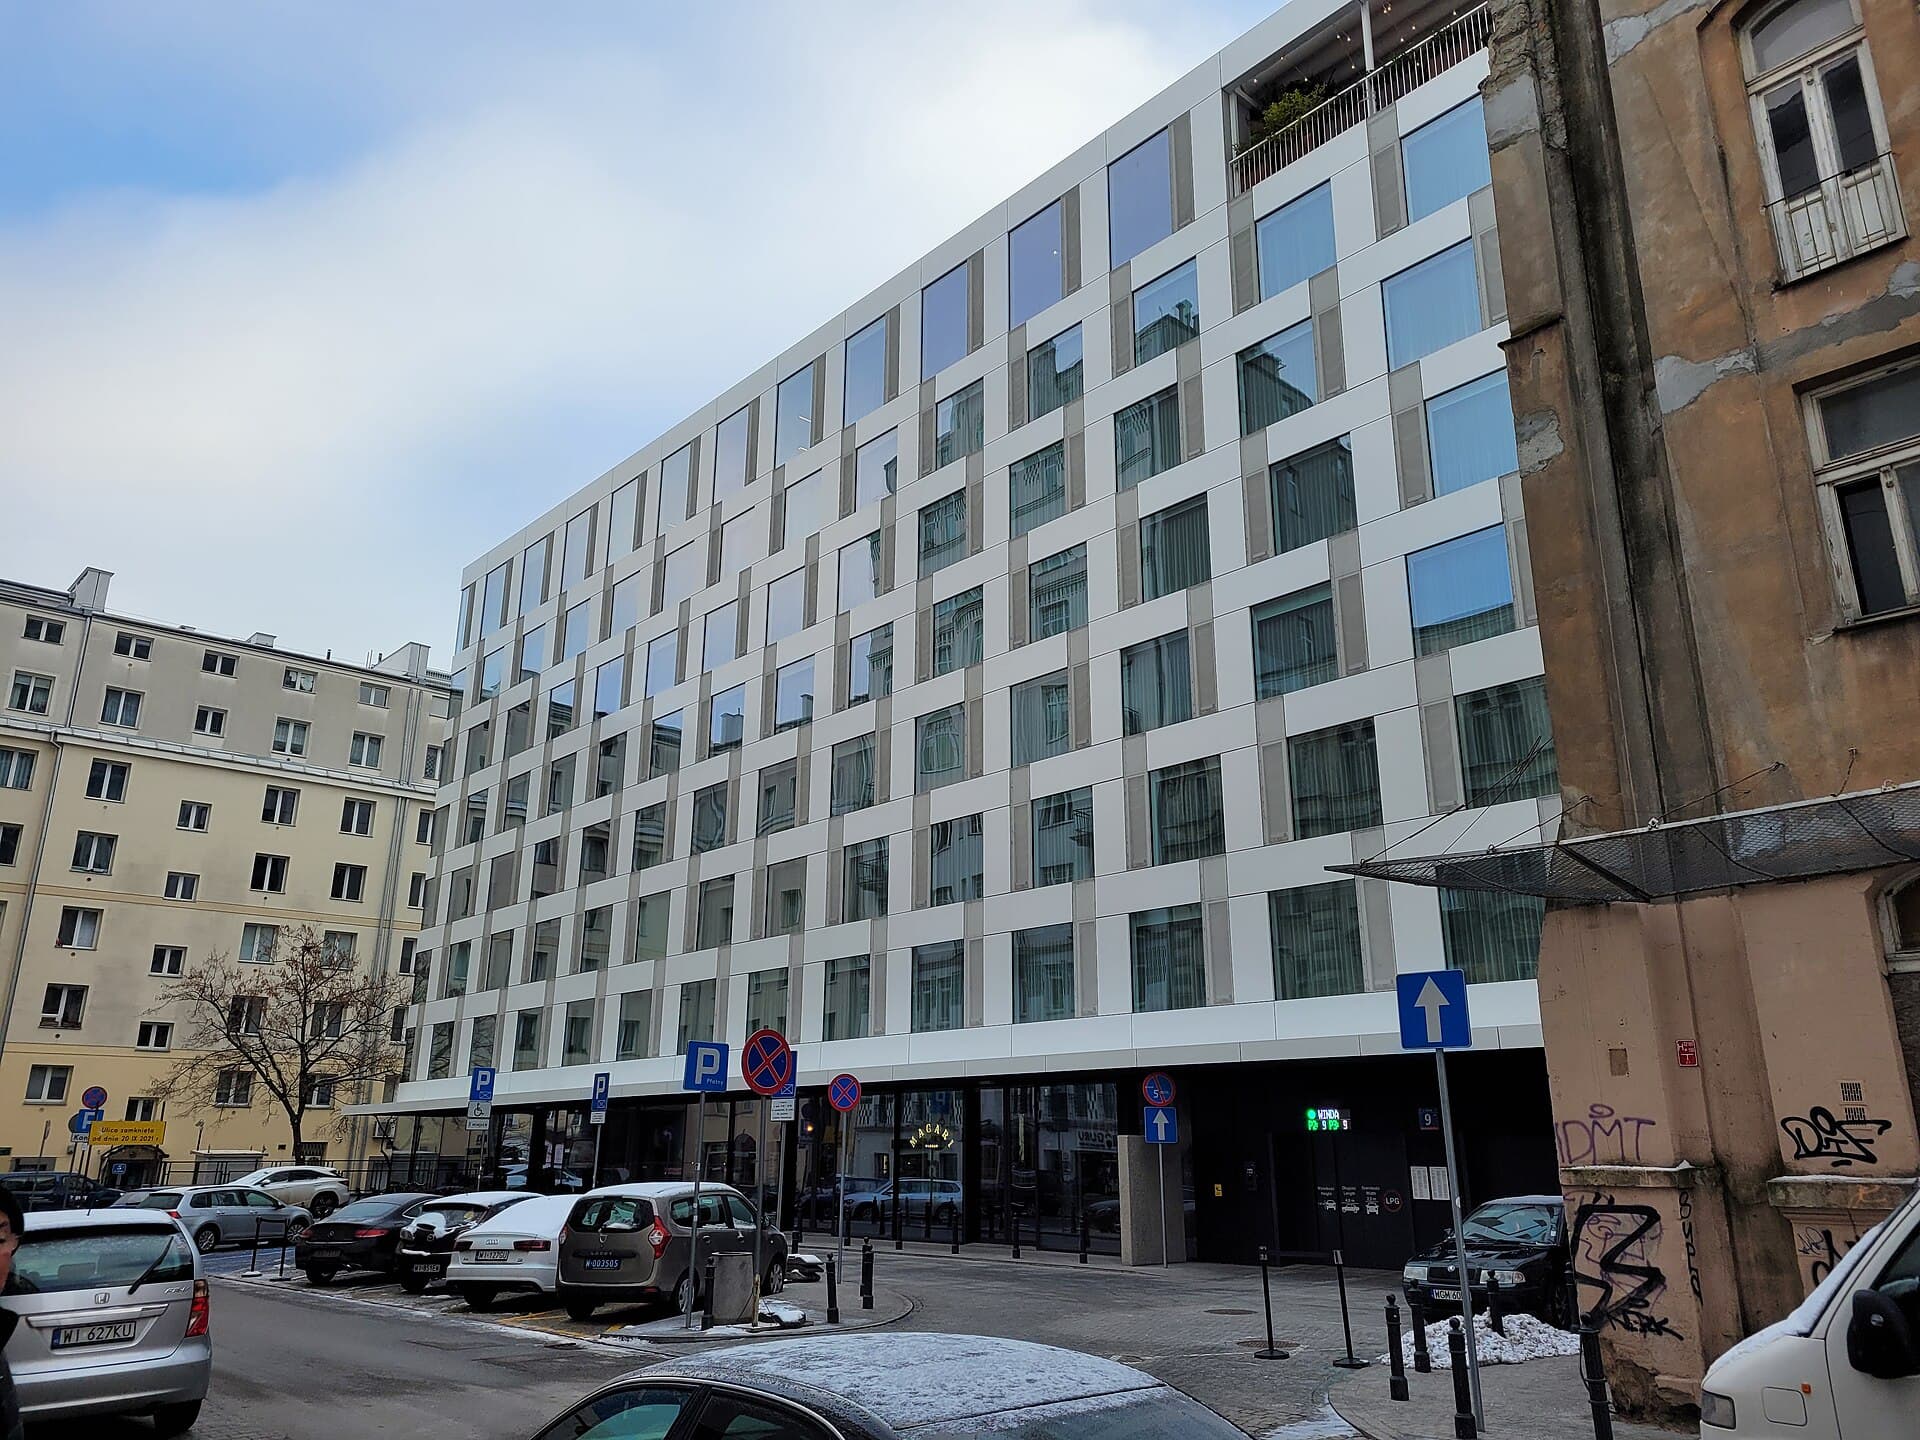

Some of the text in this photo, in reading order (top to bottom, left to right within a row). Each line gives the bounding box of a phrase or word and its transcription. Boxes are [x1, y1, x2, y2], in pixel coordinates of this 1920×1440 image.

[695, 1047, 721, 1085] P
[476, 1070, 491, 1091] P
[595, 1076, 606, 1100] P
[1153, 1089, 1159, 1099] 5
[1317, 1109, 1340, 1120] WINDA
[1424, 1113, 1431, 1125] 9
[1322, 1119, 1327, 1130] 9
[1342, 1120, 1348, 1130] 9
[909, 1123, 954, 1149] MAGARI
[1385, 1197, 1400, 1205] LPG
[1433, 1289, 1451, 1299] WGM
[63, 1324, 132, 1344] WI 627KU
